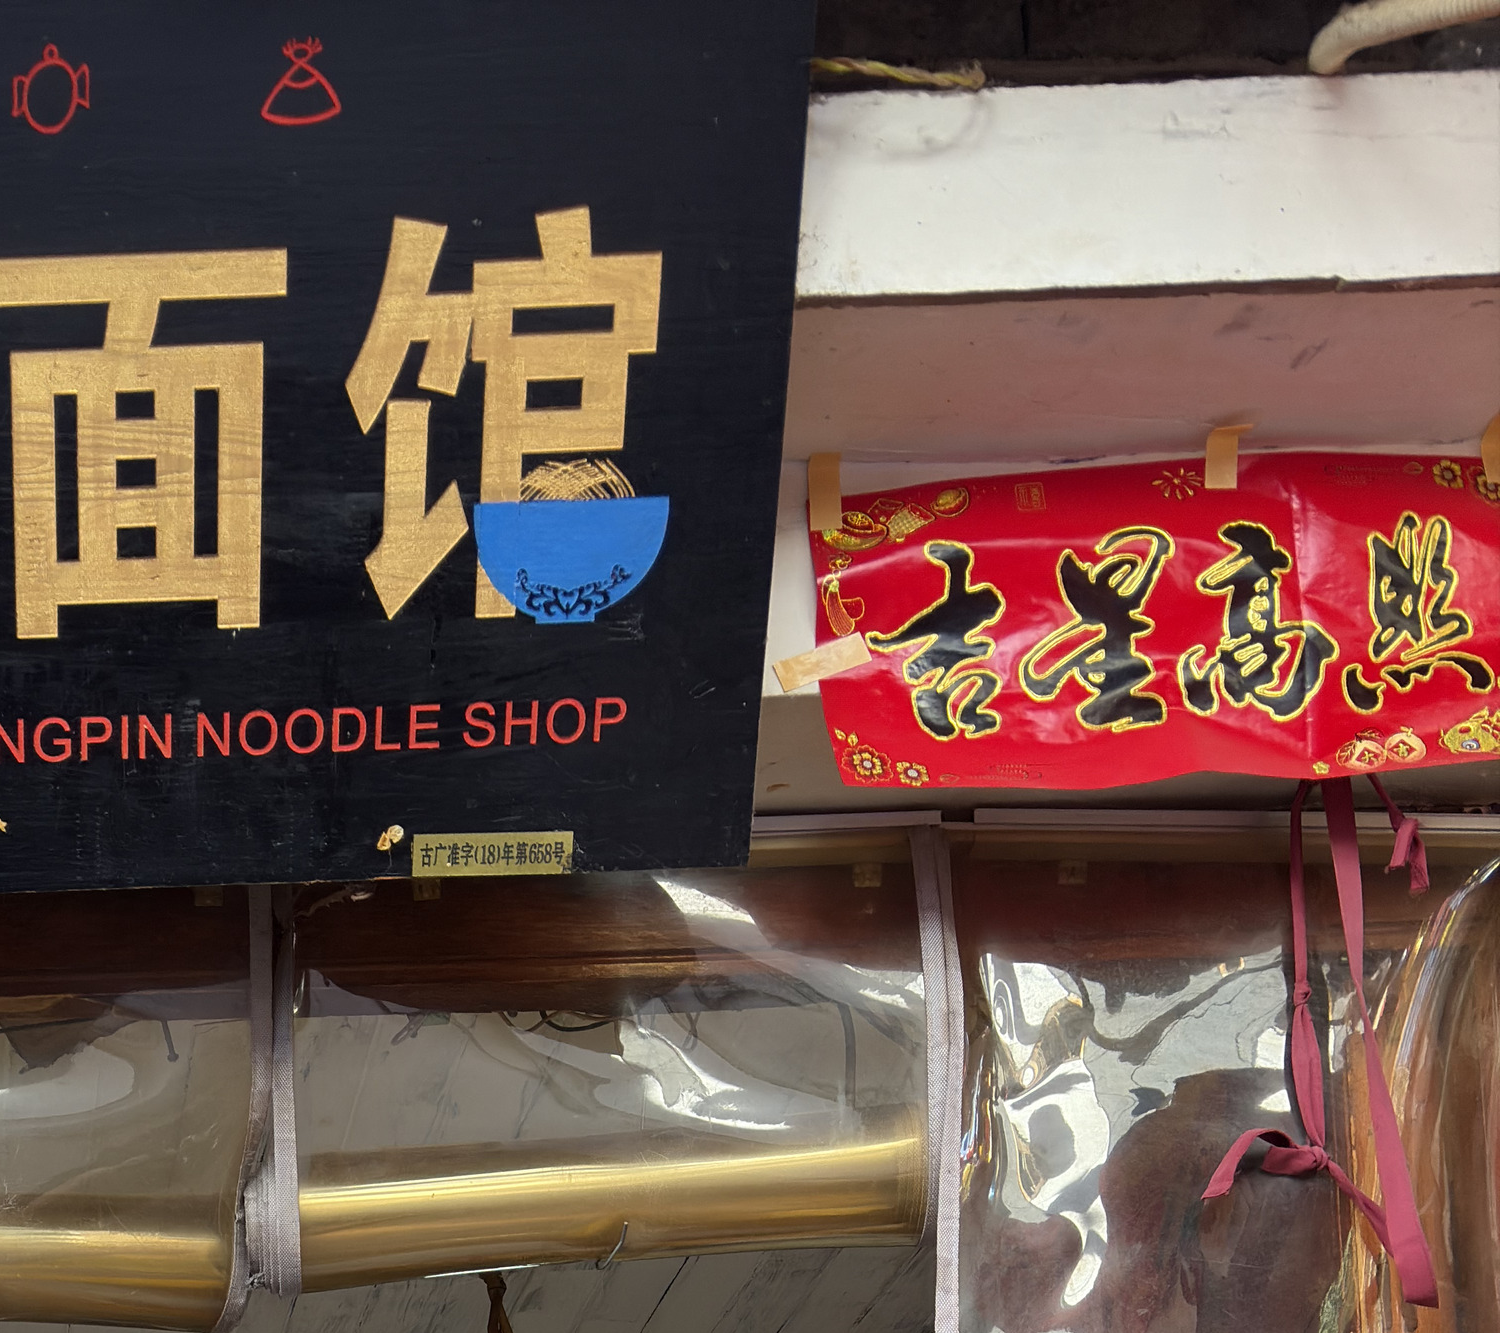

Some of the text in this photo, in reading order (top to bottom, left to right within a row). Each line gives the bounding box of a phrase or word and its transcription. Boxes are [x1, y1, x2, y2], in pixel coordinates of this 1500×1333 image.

[865, 511, 1495, 740] 吉星高照
[197, 704, 441, 757] NOODLE
[461, 697, 628, 748] SHOP
